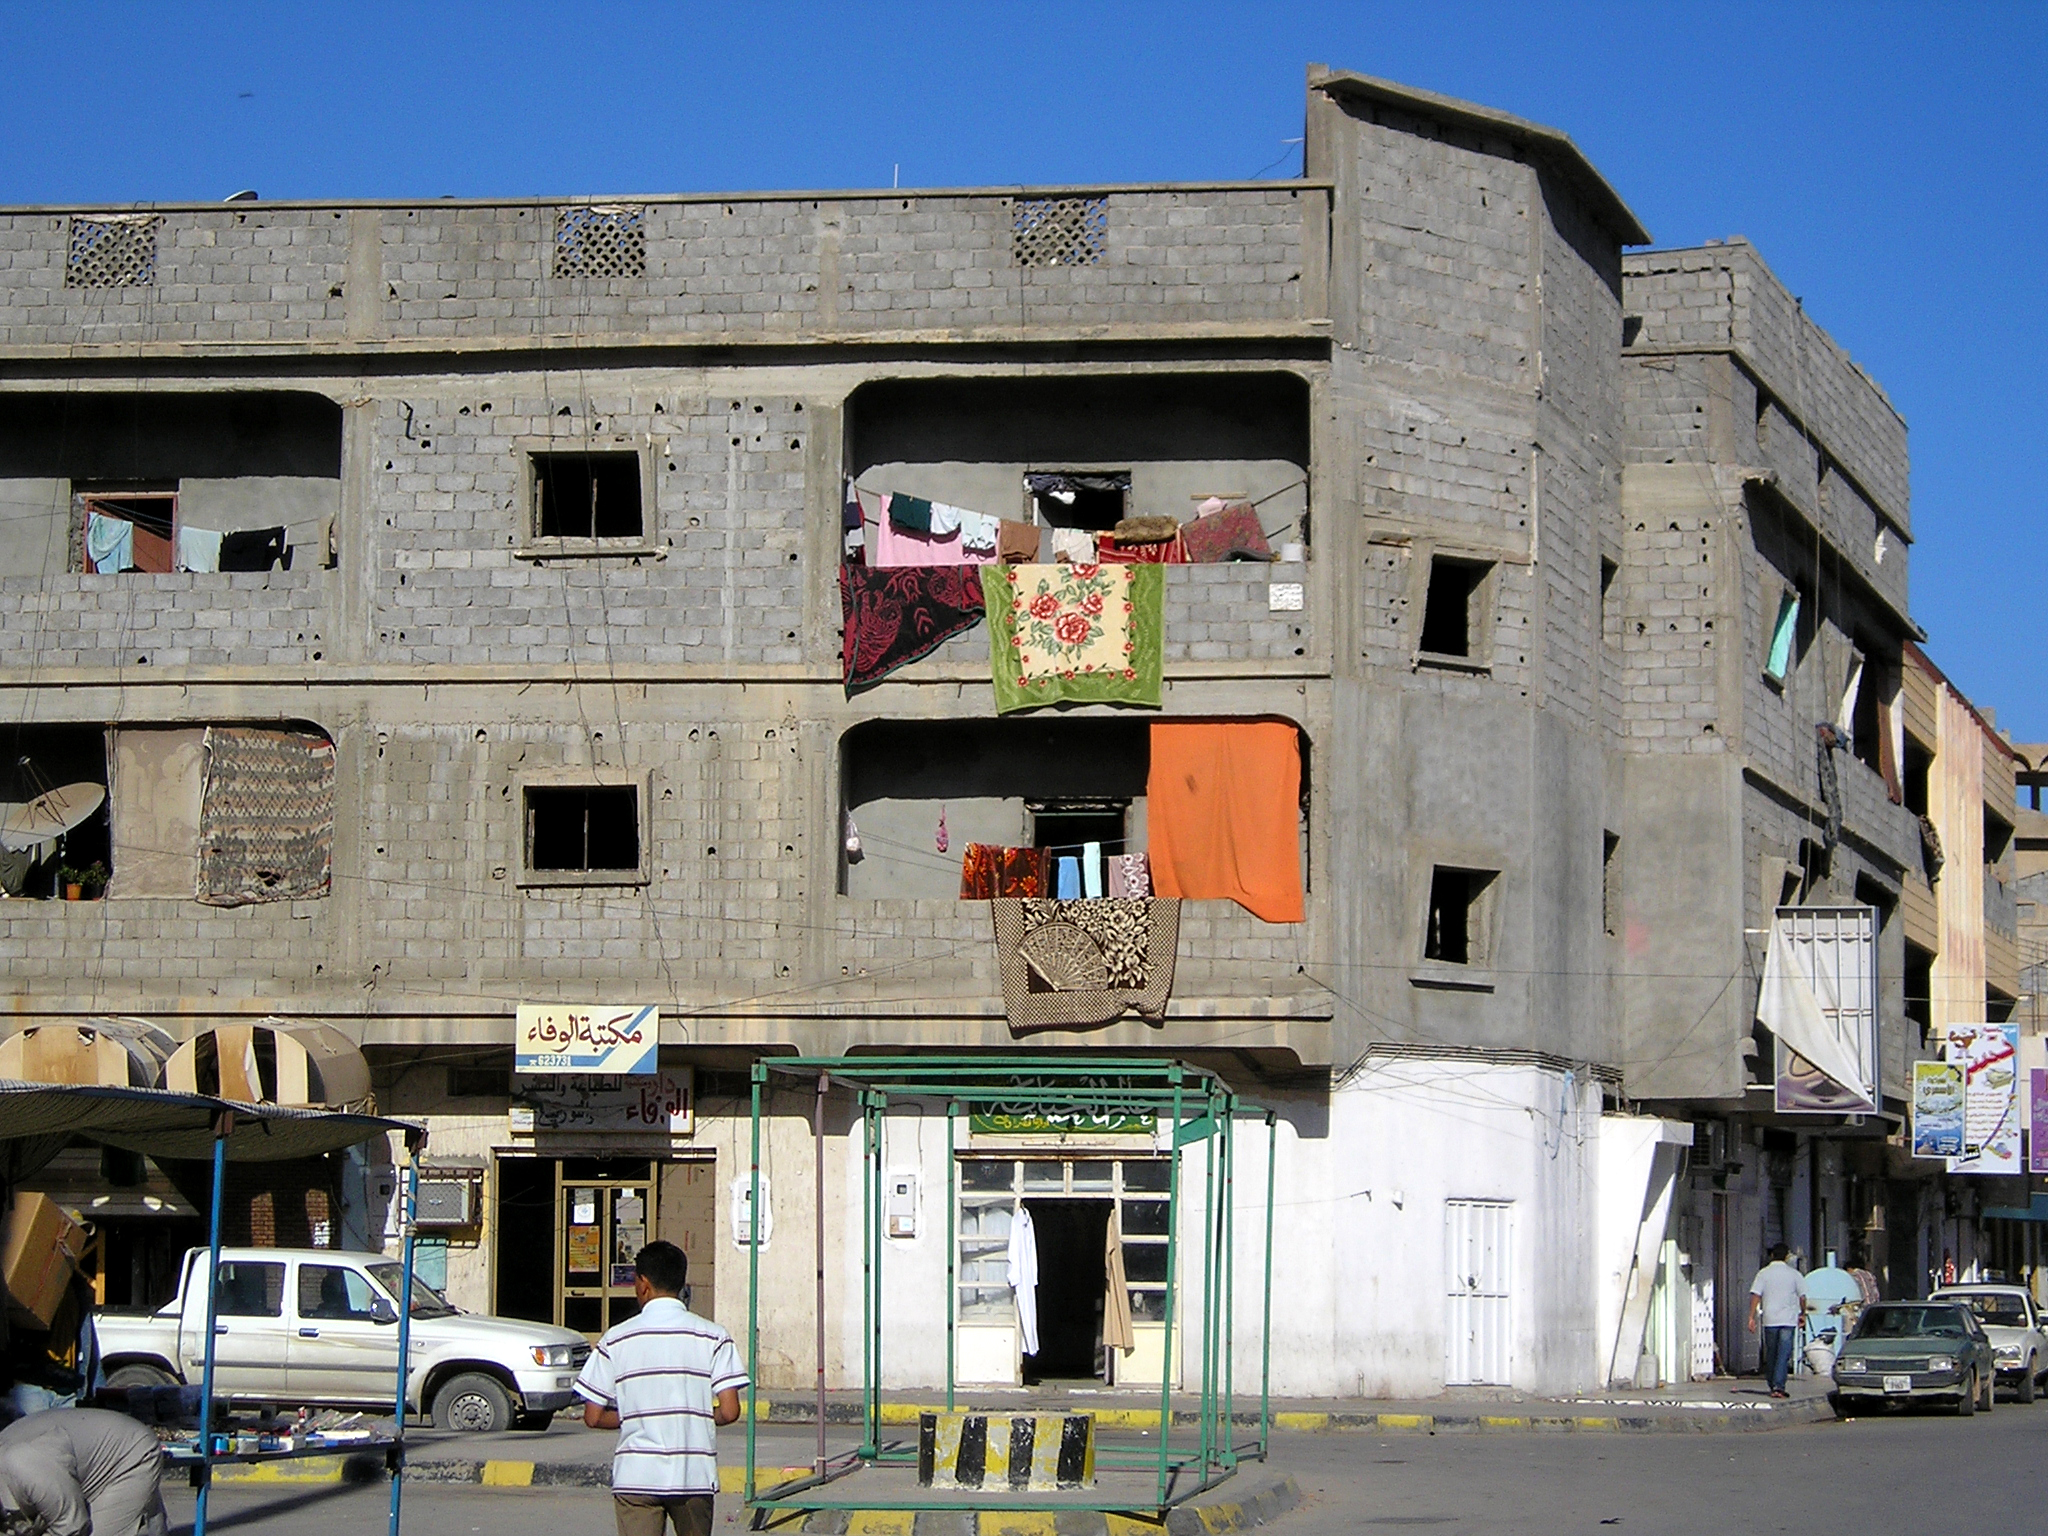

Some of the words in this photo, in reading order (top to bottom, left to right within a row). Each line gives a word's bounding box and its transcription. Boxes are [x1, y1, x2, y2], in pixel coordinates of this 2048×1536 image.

[528, 1014, 578, 1052] الوفاء
[579, 1013, 643, 1052] مكتبة
[538, 1055, 572, 1066] 623731
[626, 1088, 688, 1124] الوفاء
